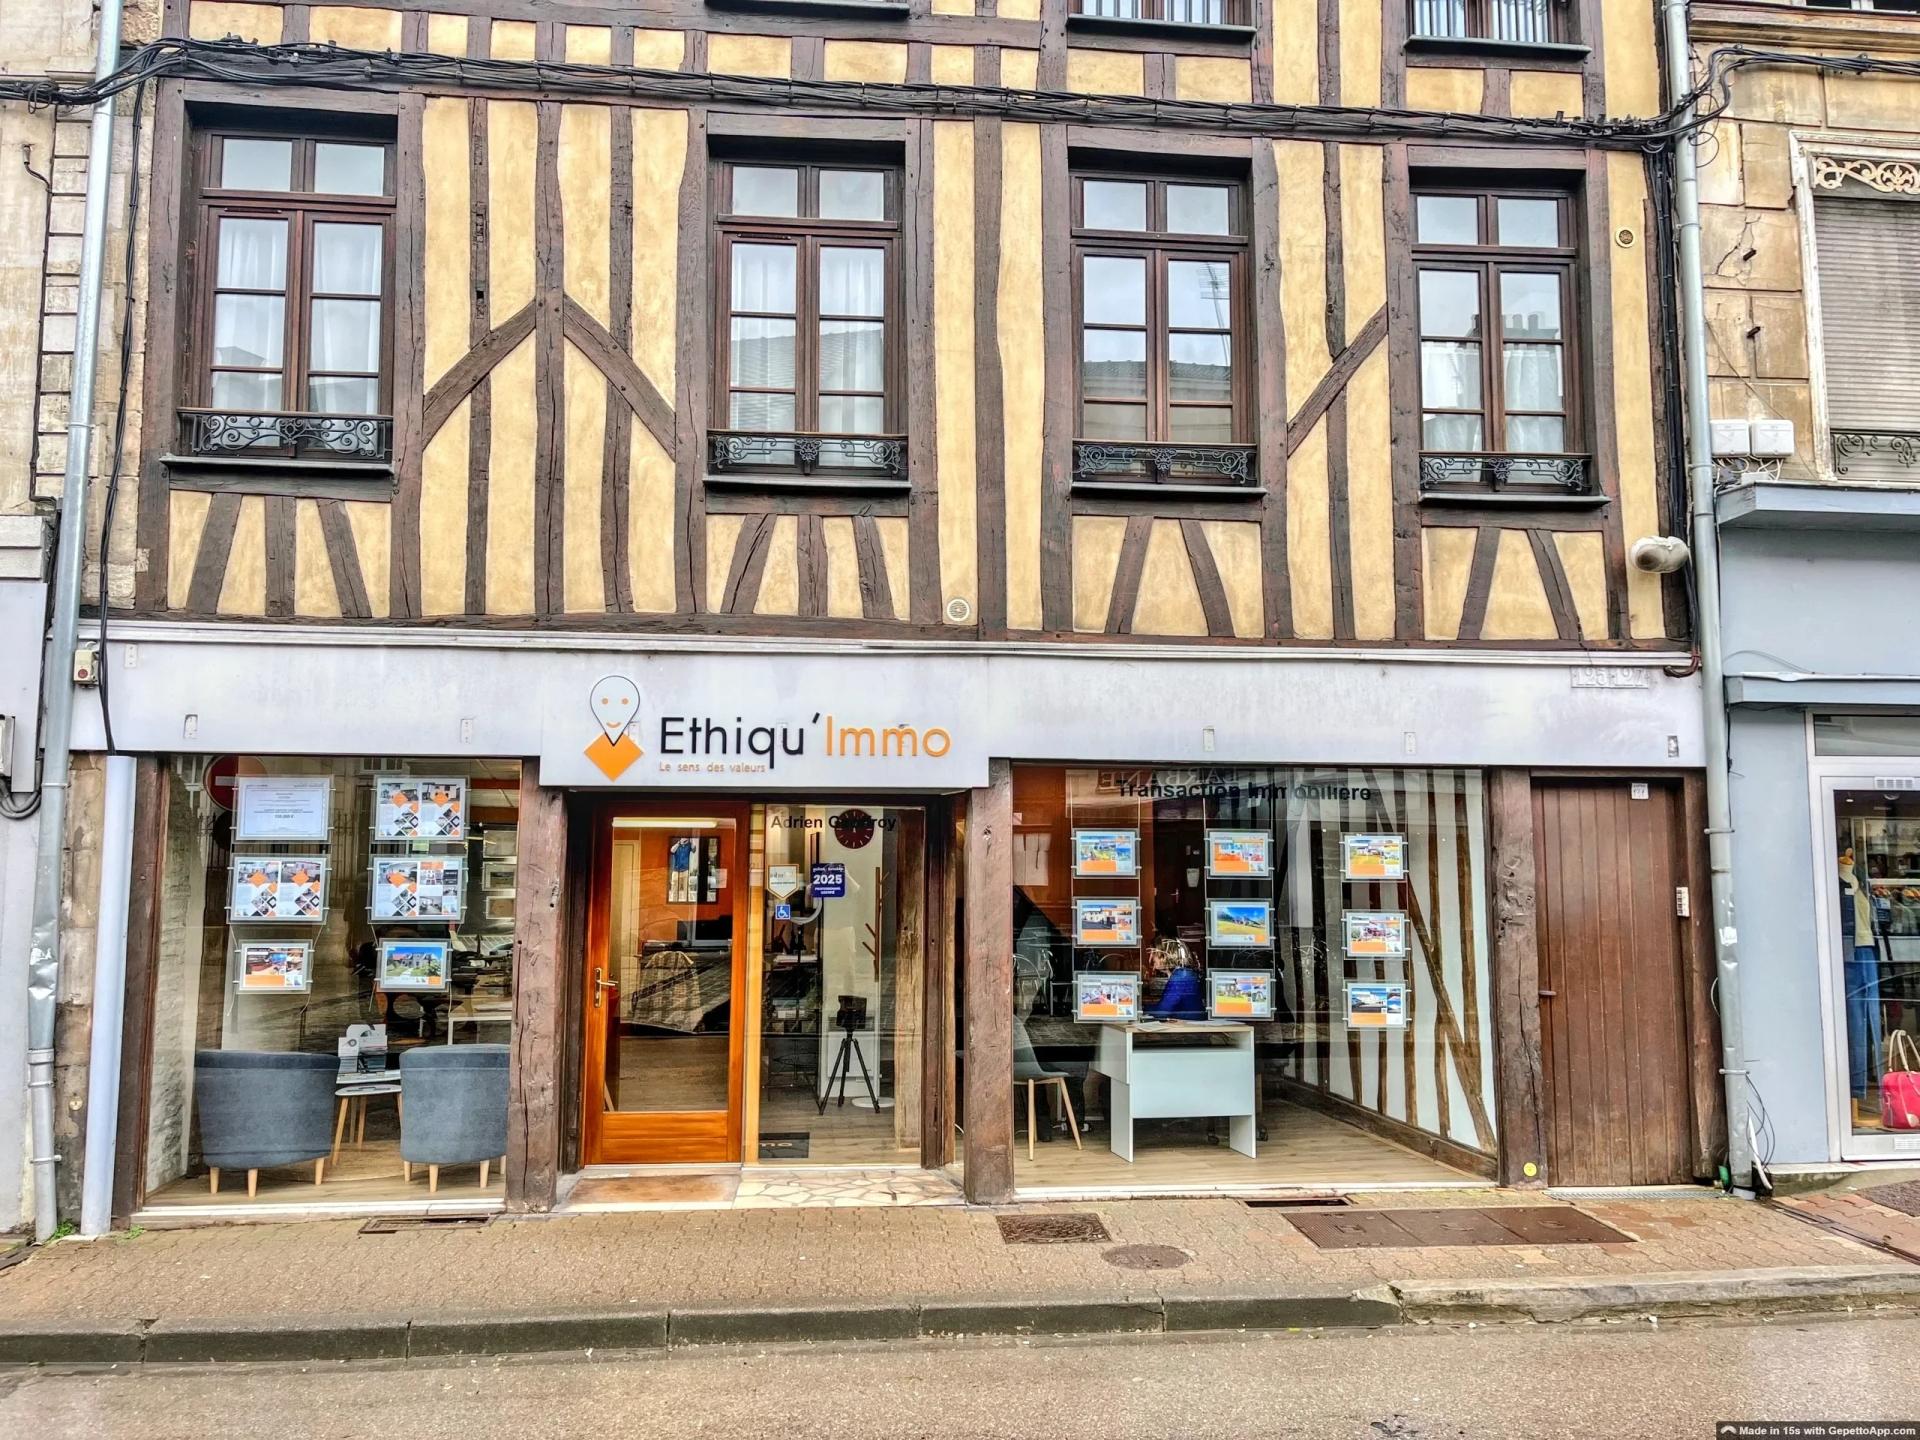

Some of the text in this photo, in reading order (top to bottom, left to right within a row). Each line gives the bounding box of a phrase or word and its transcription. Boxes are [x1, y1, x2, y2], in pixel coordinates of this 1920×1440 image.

[661, 713, 951, 769] Ethiqu'Immo
[659, 761, 766, 774] Le sens des valeurs
[1119, 779, 1241, 801] Transaction
[771, 815, 822, 828] Adrien
[813, 874, 842, 884] 2025
